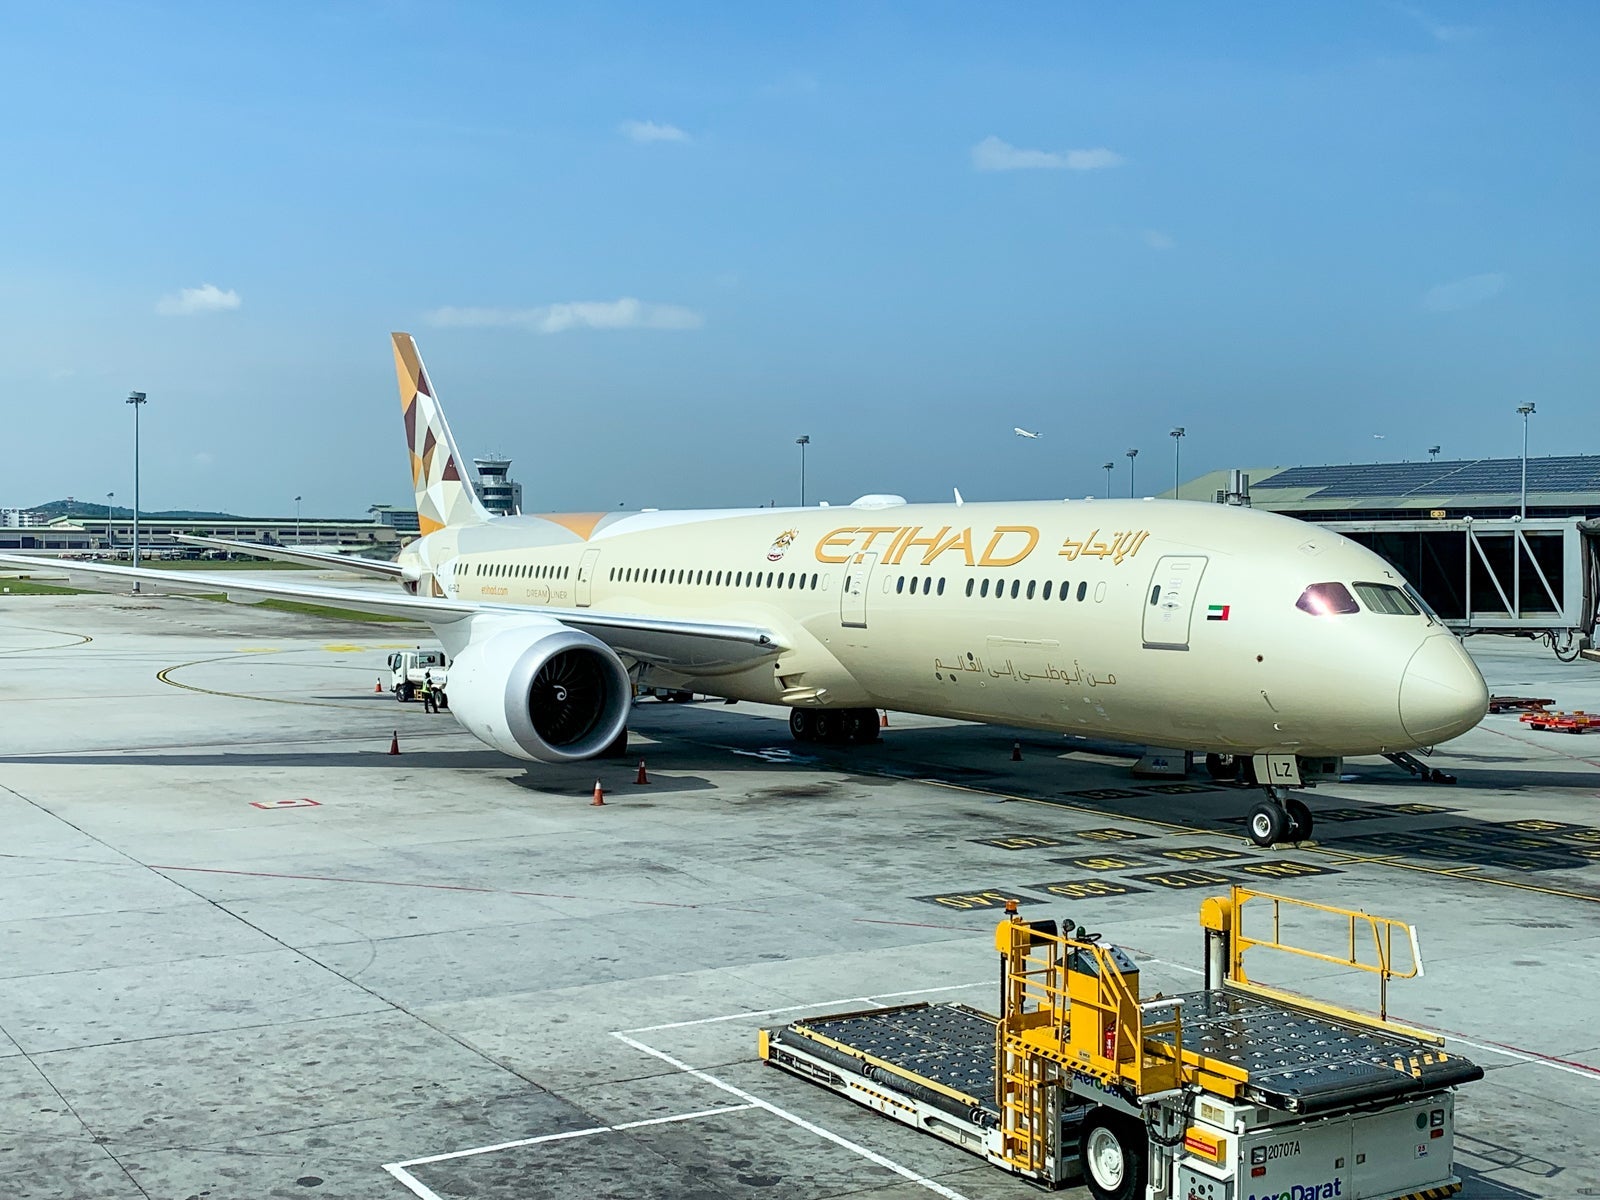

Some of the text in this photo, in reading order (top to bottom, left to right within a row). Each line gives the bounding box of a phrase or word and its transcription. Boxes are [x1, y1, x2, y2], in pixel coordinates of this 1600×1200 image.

[814, 526, 1040, 567] ETIHAD
[1083, 668, 1117, 688] من
[1273, 762, 1293, 777] LZ
[1145, 872, 1229, 886] 772
[1048, 881, 1125, 897] 330
[1268, 1141, 1300, 1160] 20707A
